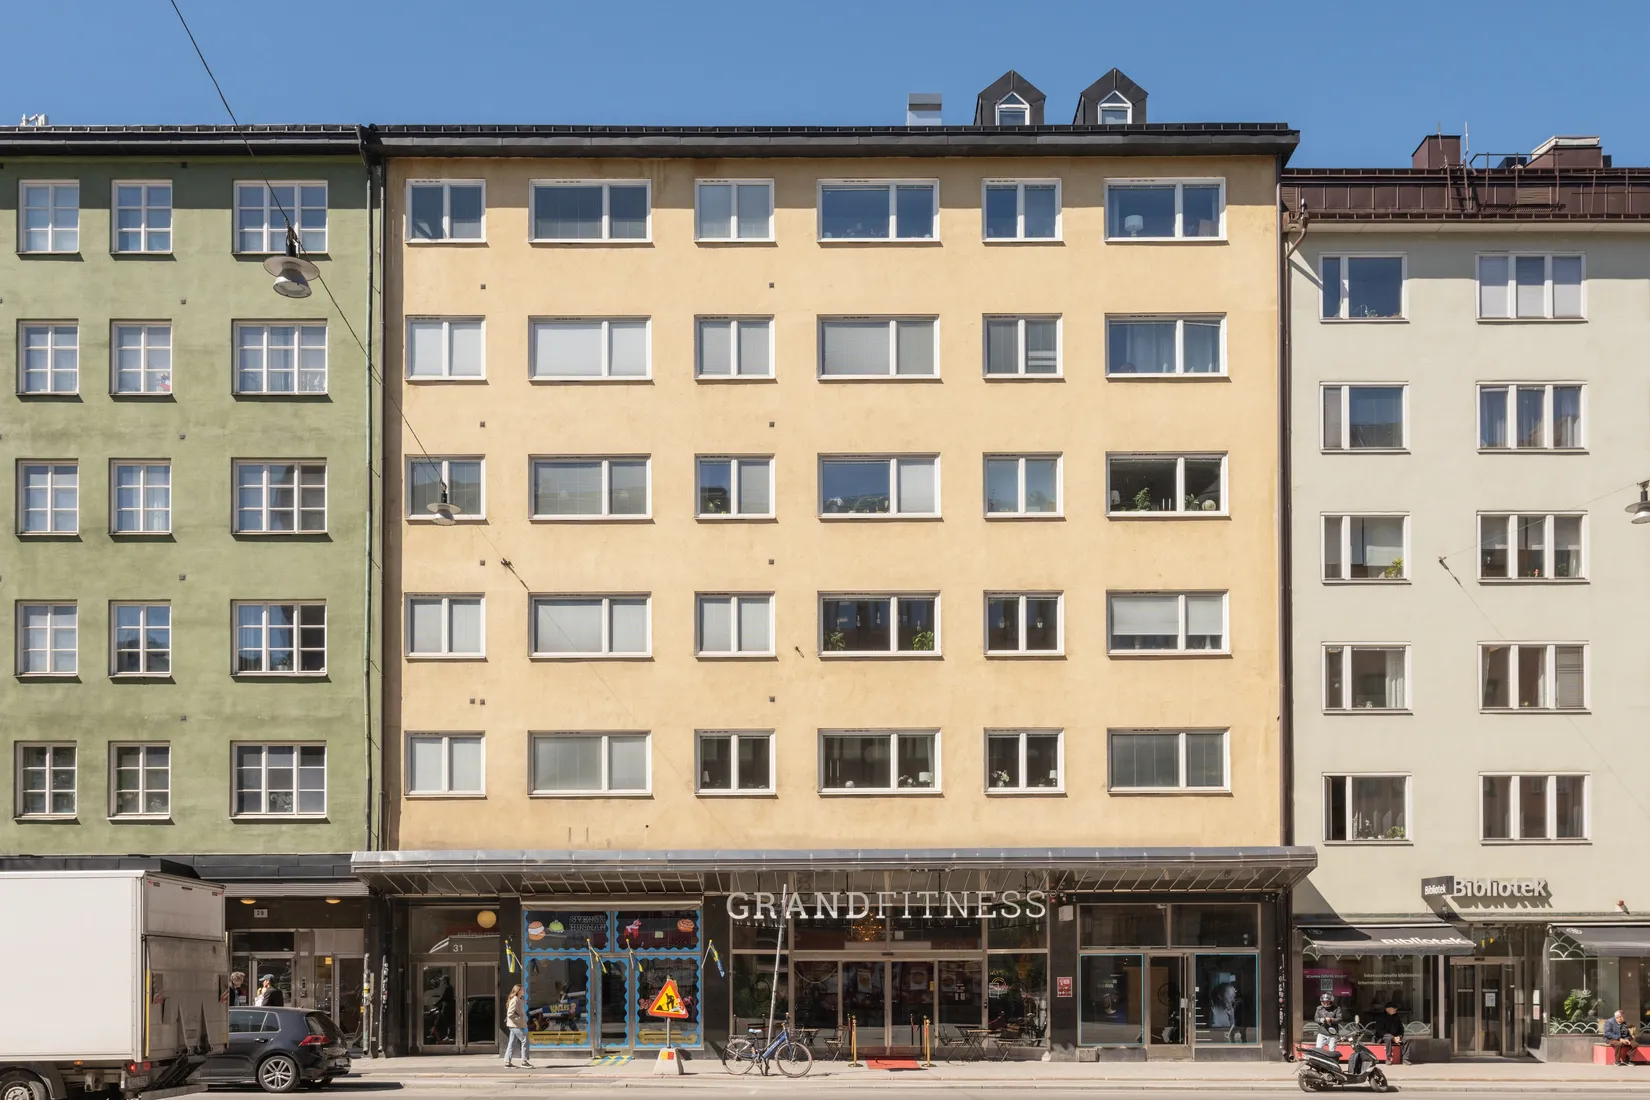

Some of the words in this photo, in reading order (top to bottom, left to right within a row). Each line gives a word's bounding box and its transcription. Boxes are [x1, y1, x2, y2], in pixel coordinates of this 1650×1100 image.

[1424, 884, 1447, 896] Bibliotek
[1453, 878, 1548, 897] Bibliotek
[1381, 937, 1466, 945] Bibliotek
[452, 944, 463, 952] 31
